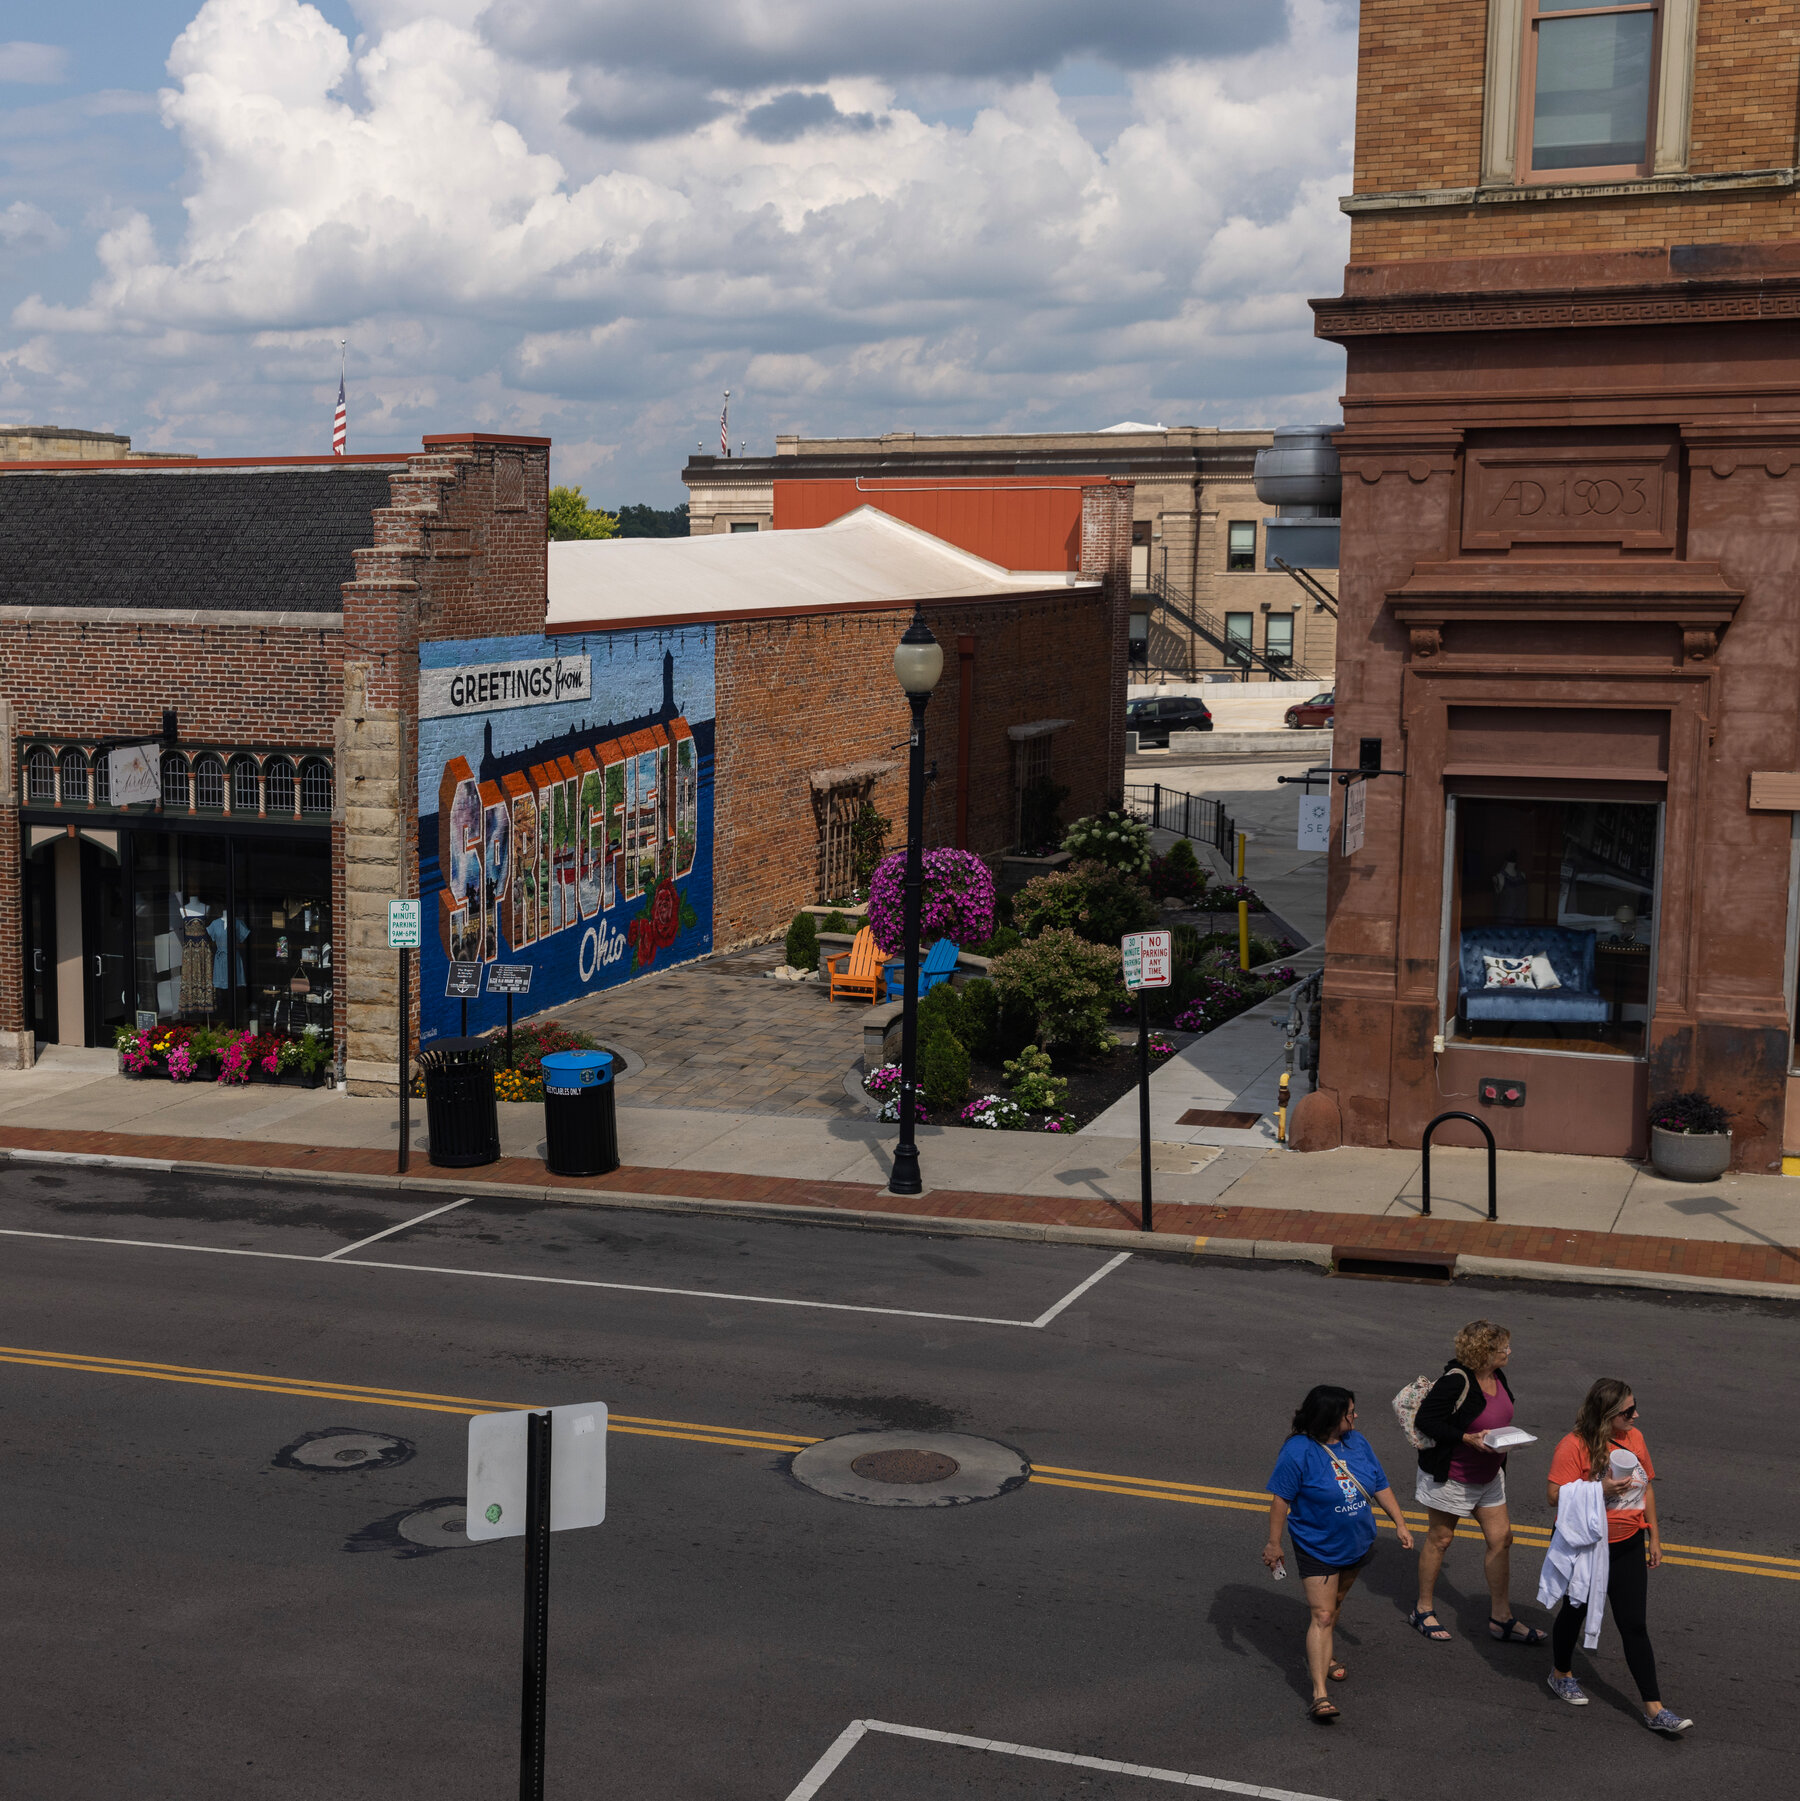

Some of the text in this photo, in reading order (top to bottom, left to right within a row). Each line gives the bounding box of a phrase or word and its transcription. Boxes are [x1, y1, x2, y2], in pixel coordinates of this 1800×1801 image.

[450, 659, 584, 707] GREETINGS from
[440, 717, 698, 963] SPRINGFIELD
[400, 903, 410, 911] 30
[1149, 936, 1162, 947] NO
[578, 918, 626, 983] Ohio
[1143, 948, 1168, 958] PARKING
[1148, 966, 1162, 975] TIME
